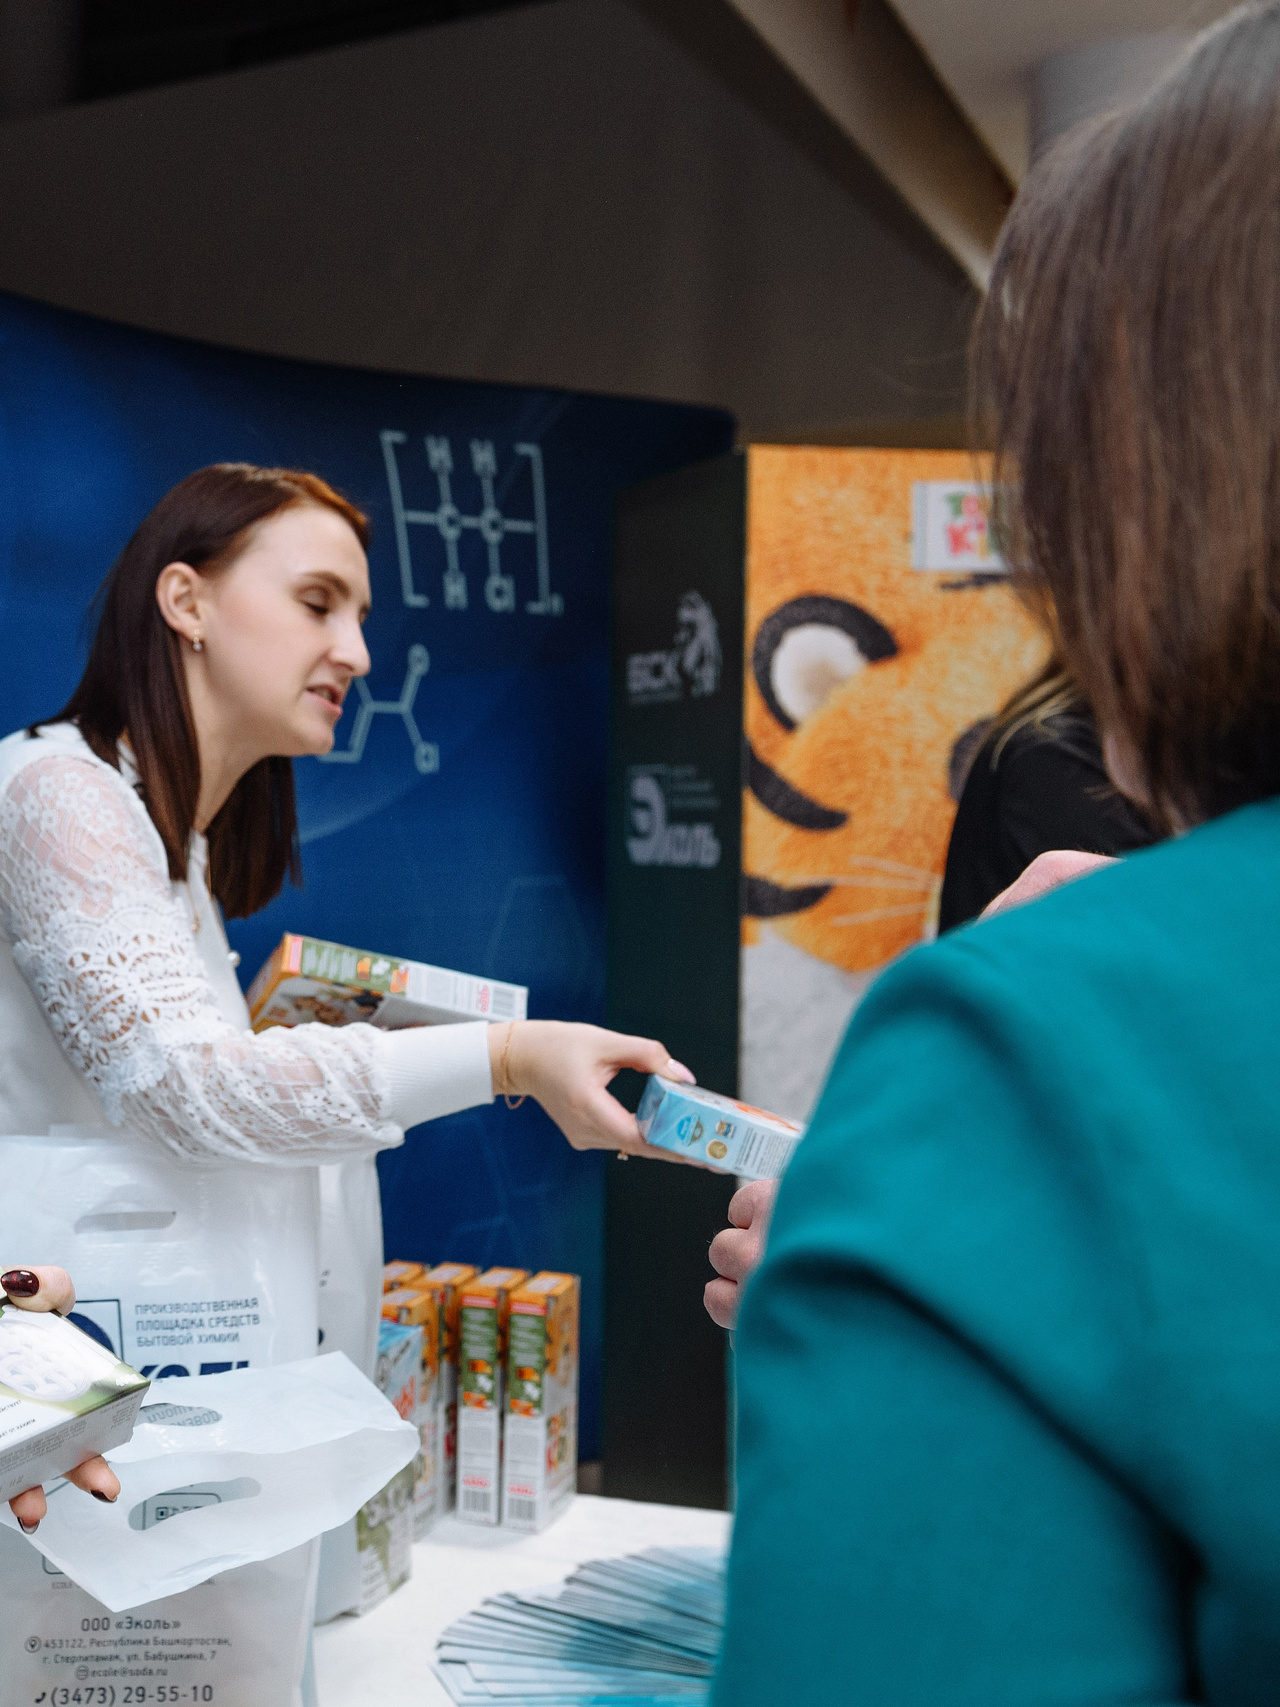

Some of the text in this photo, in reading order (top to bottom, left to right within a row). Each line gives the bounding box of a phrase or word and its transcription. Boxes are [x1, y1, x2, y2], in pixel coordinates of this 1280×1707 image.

[134, 1298, 260, 1316] ПРОИЗВОДСТВЕННАЯ
[135, 1314, 261, 1332] ПЛОЩАДКА СРЕДСТВ
[136, 1331, 240, 1348] БЫТОВОЙ ХИМИИ
[80, 1616, 182, 1632] ООО «Эколь»
[42, 1636, 233, 1650] 453122, Республика Башкортостан,
[143, 1651, 208, 1663] Бабушкина,
[209, 1650, 217, 1660] 7
[50, 1684, 214, 1707] (3473) 29-55-10
